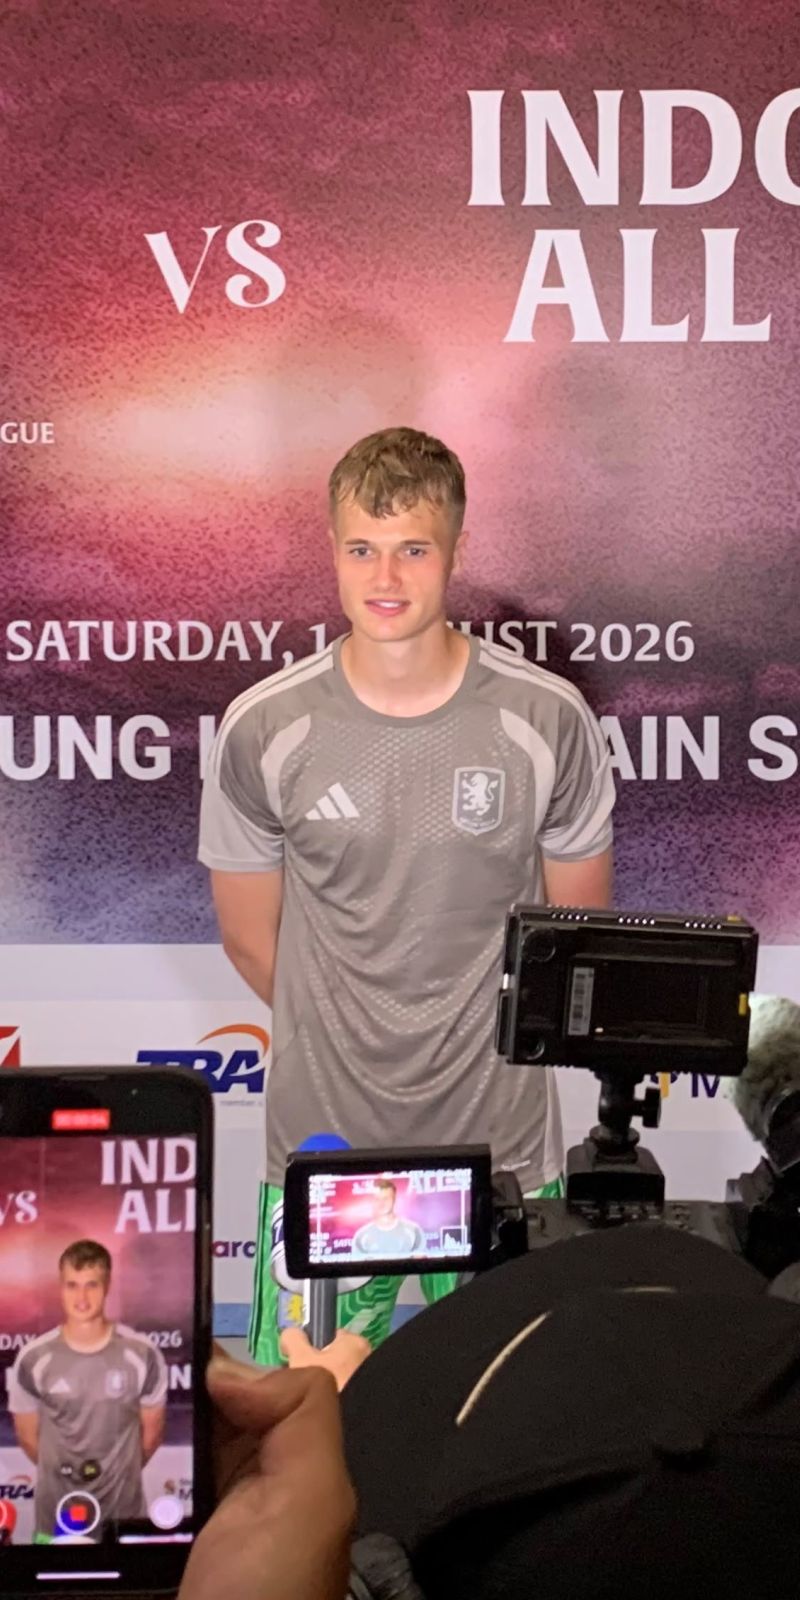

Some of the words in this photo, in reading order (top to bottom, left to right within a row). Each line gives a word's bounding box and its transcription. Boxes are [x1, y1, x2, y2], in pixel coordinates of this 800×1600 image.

[144, 219, 286, 314] VS
[503, 228, 771, 342] ALL
[0, 422, 55, 444] GUE
[6, 619, 294, 668] SATURDAY,
[569, 620, 695, 661] 2026
[0, 714, 171, 781] UNG
[599, 715, 720, 780] AIN
[148, 1330, 183, 1348] 026
